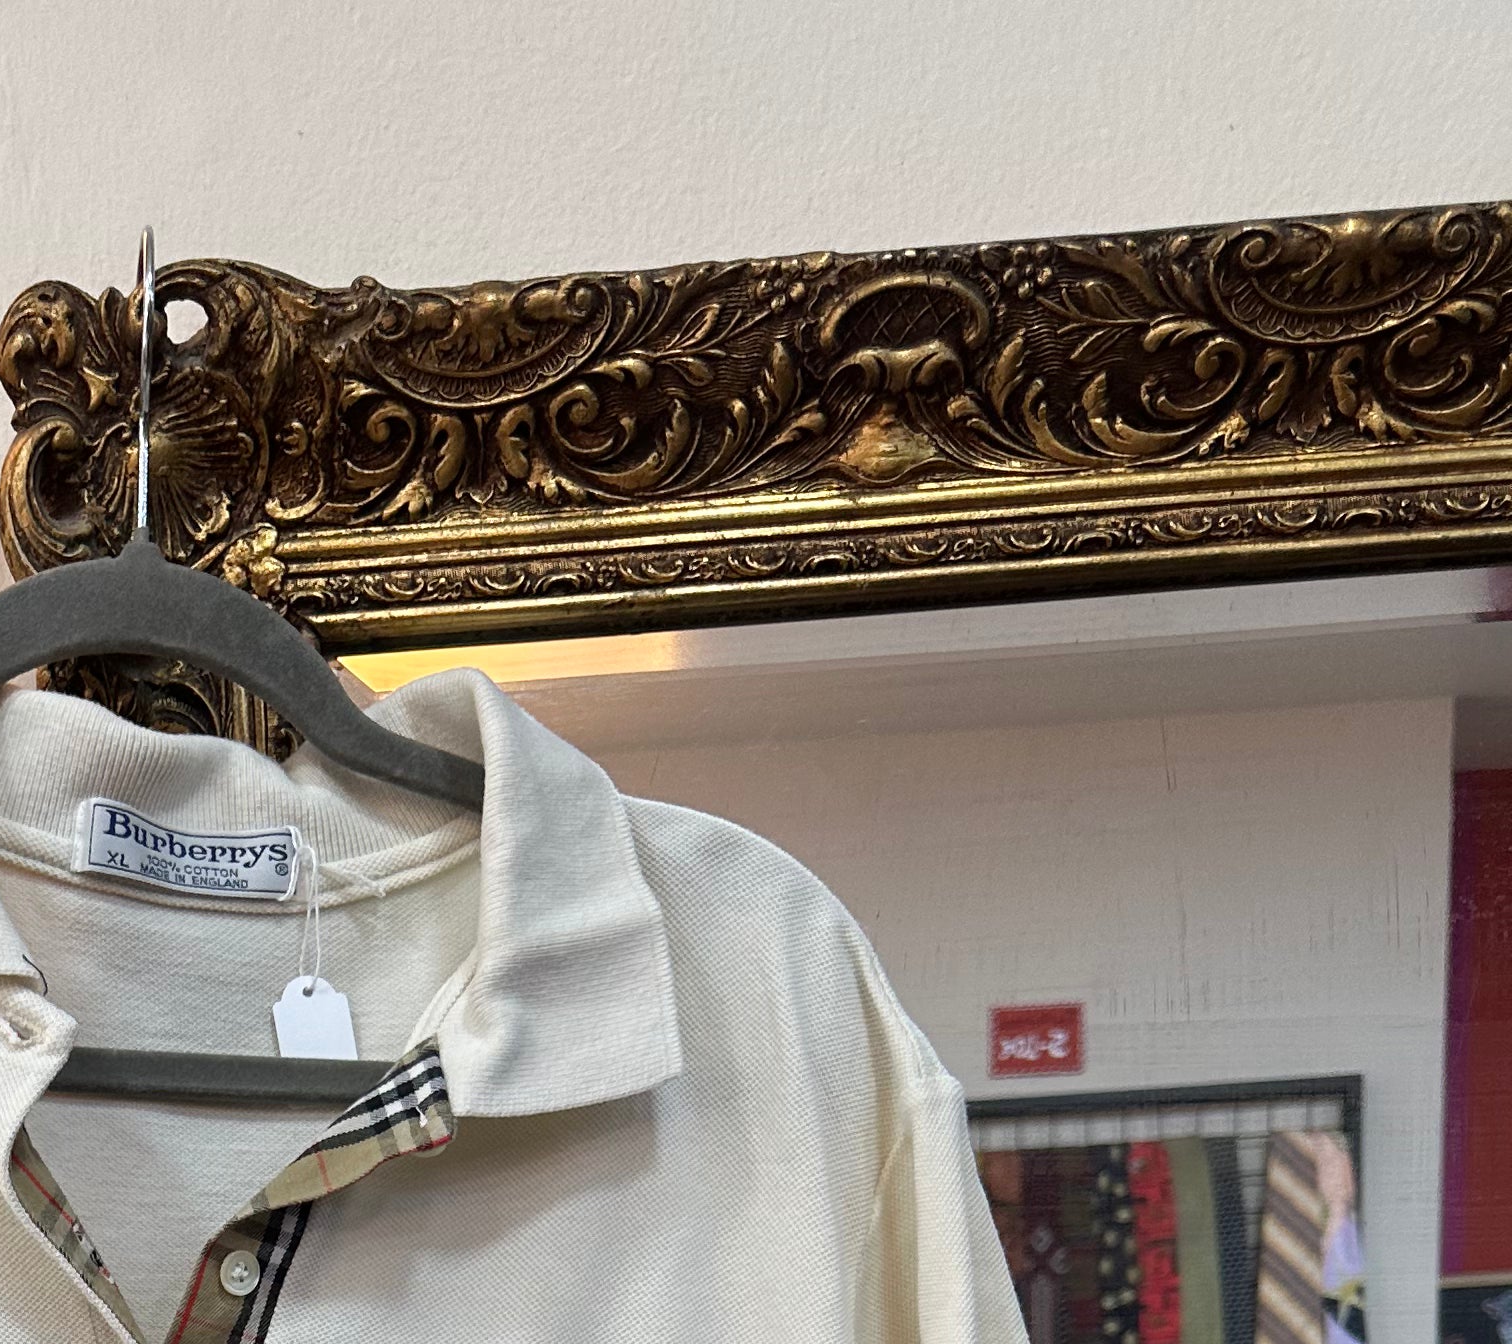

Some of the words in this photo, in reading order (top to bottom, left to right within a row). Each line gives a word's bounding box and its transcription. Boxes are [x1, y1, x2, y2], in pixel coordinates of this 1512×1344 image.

[103, 809, 289, 868] Burberrys
[107, 850, 130, 868] XL
[140, 862, 172, 881] MADE
[174, 873, 187, 885] IN
[191, 876, 250, 890] ENGLAND
[184, 864, 239, 878] COTTON
